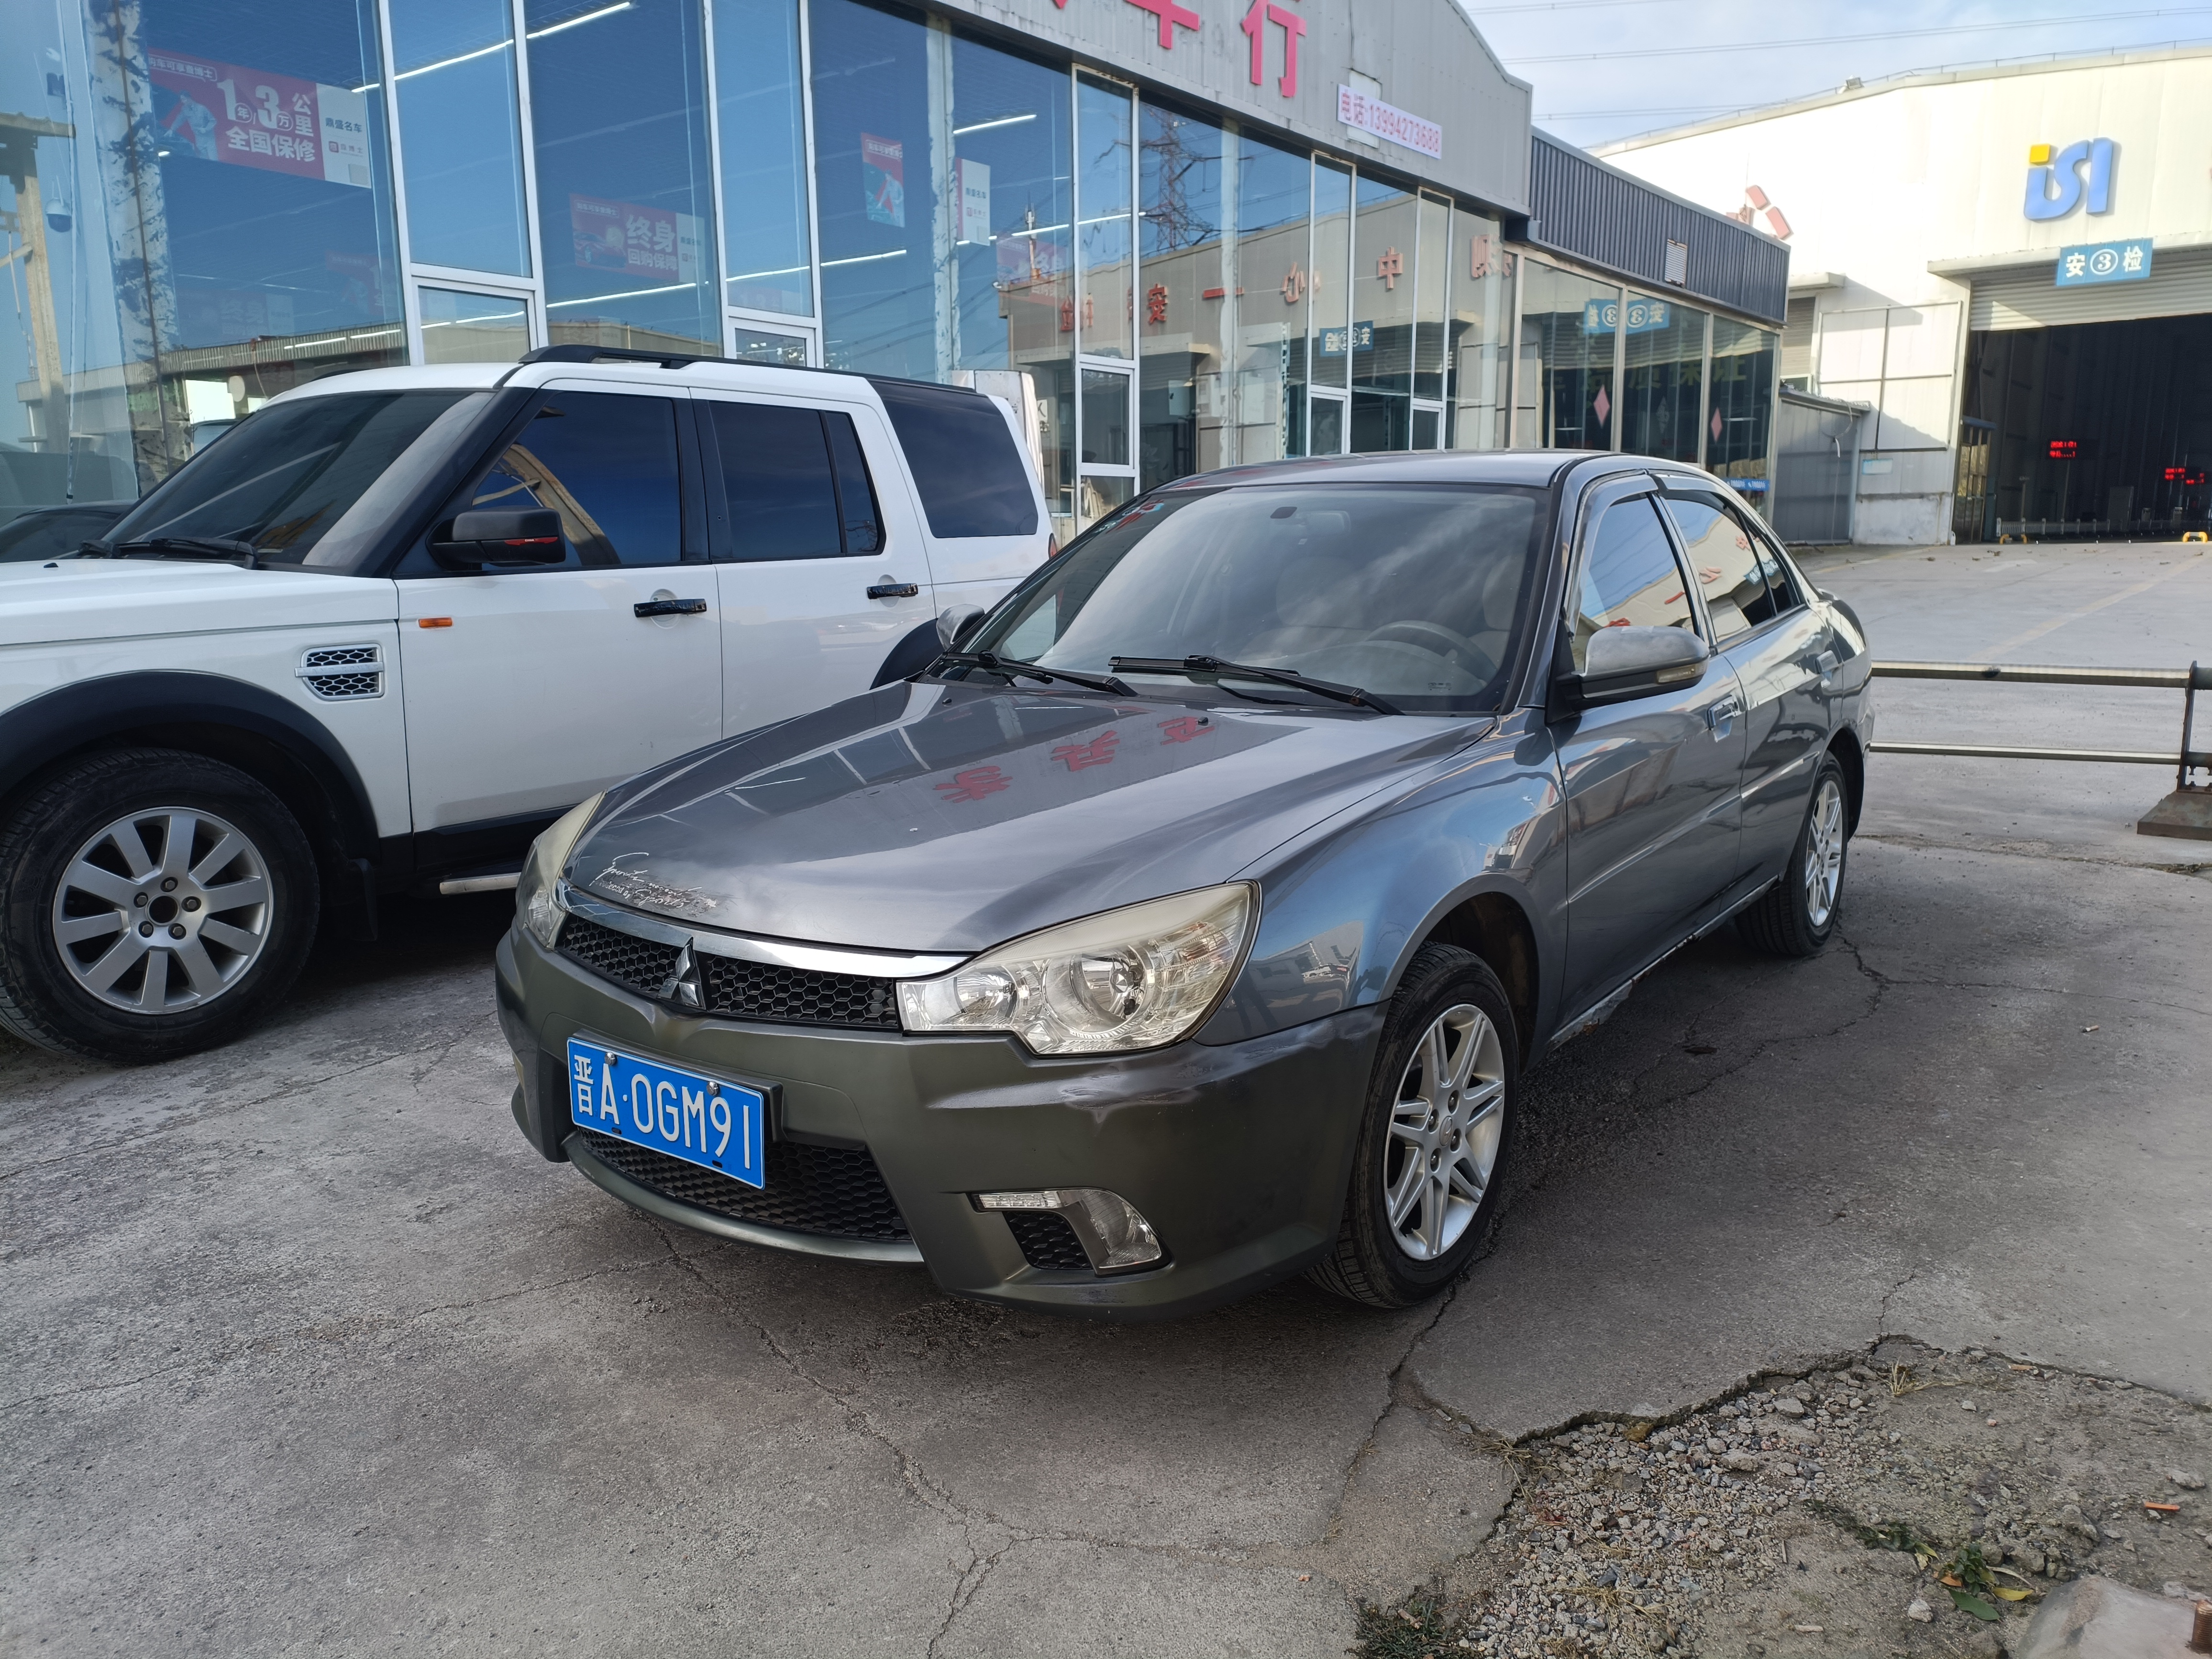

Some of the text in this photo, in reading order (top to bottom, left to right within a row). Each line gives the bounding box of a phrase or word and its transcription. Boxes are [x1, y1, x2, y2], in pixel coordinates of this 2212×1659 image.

[225, 126, 316, 162] 全国保修
[625, 214, 675, 253] 终身
[627, 248, 678, 271] 回购保障
